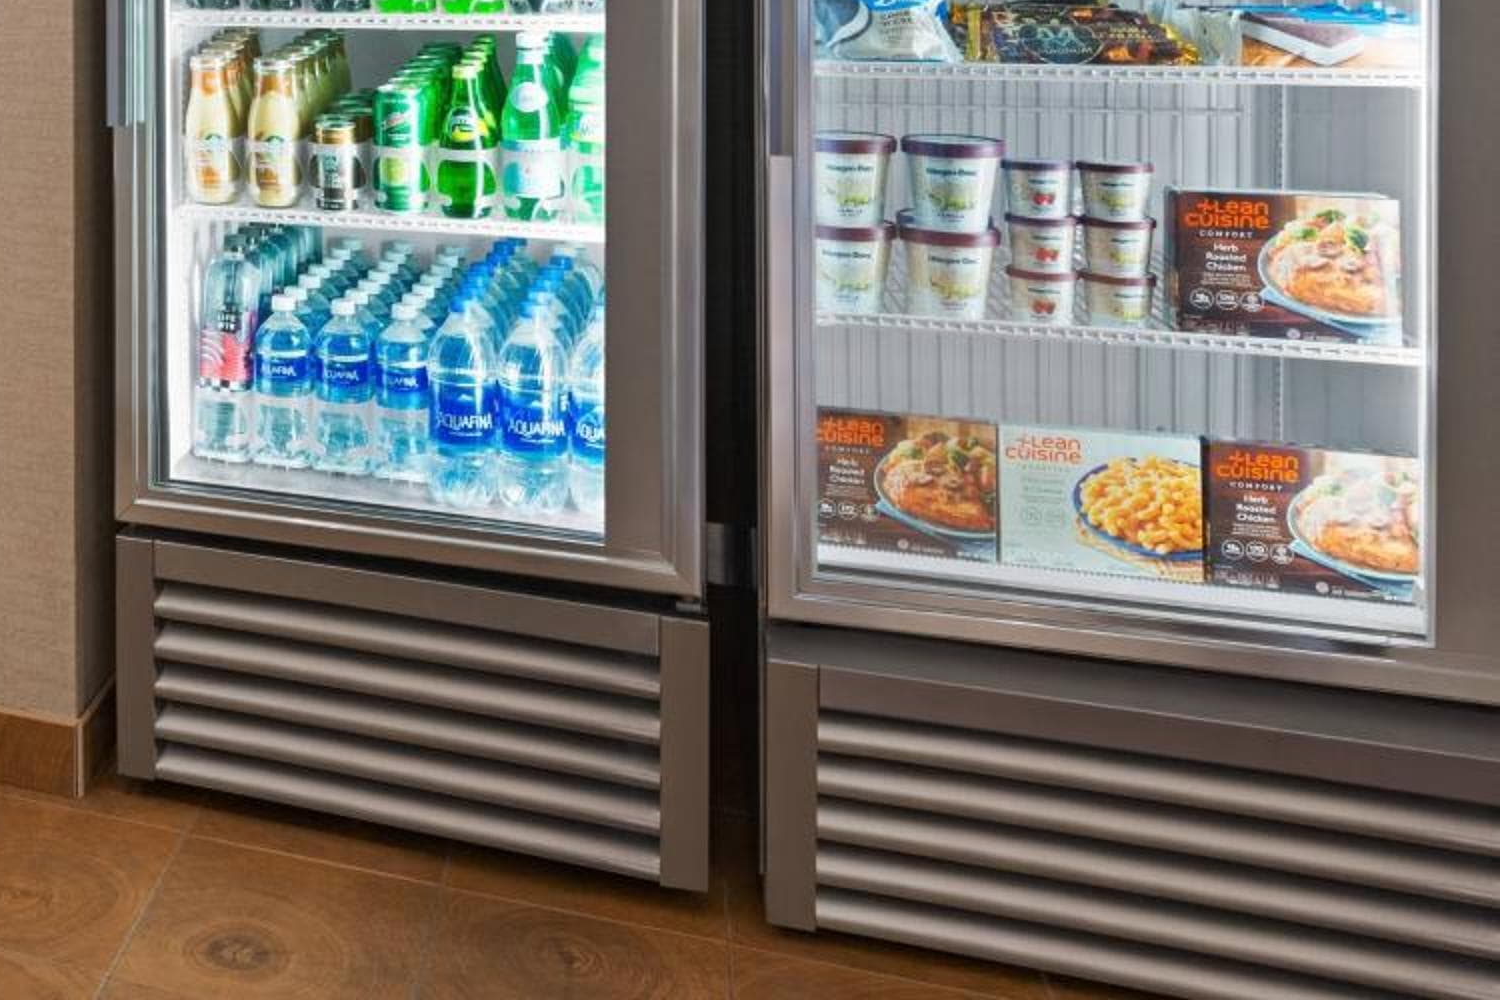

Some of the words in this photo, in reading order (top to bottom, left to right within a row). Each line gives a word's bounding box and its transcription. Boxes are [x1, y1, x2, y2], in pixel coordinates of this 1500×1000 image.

[1215, 200, 1268, 214] Lean
[1186, 213, 1269, 229] cuisine
[1199, 230, 1252, 238] COMFORT
[1213, 243, 1238, 252] Herb
[436, 412, 492, 429] AQUAFINA
[508, 419, 565, 437] AQUAFINA
[837, 419, 884, 435] Lean
[576, 422, 604, 439] AQUA
[1031, 436, 1081, 450] Lean
[1005, 447, 1081, 463] cuisine
[1246, 454, 1297, 469] Lean
[1217, 465, 1297, 483] cuisine
[1229, 481, 1283, 491] COMFORT
